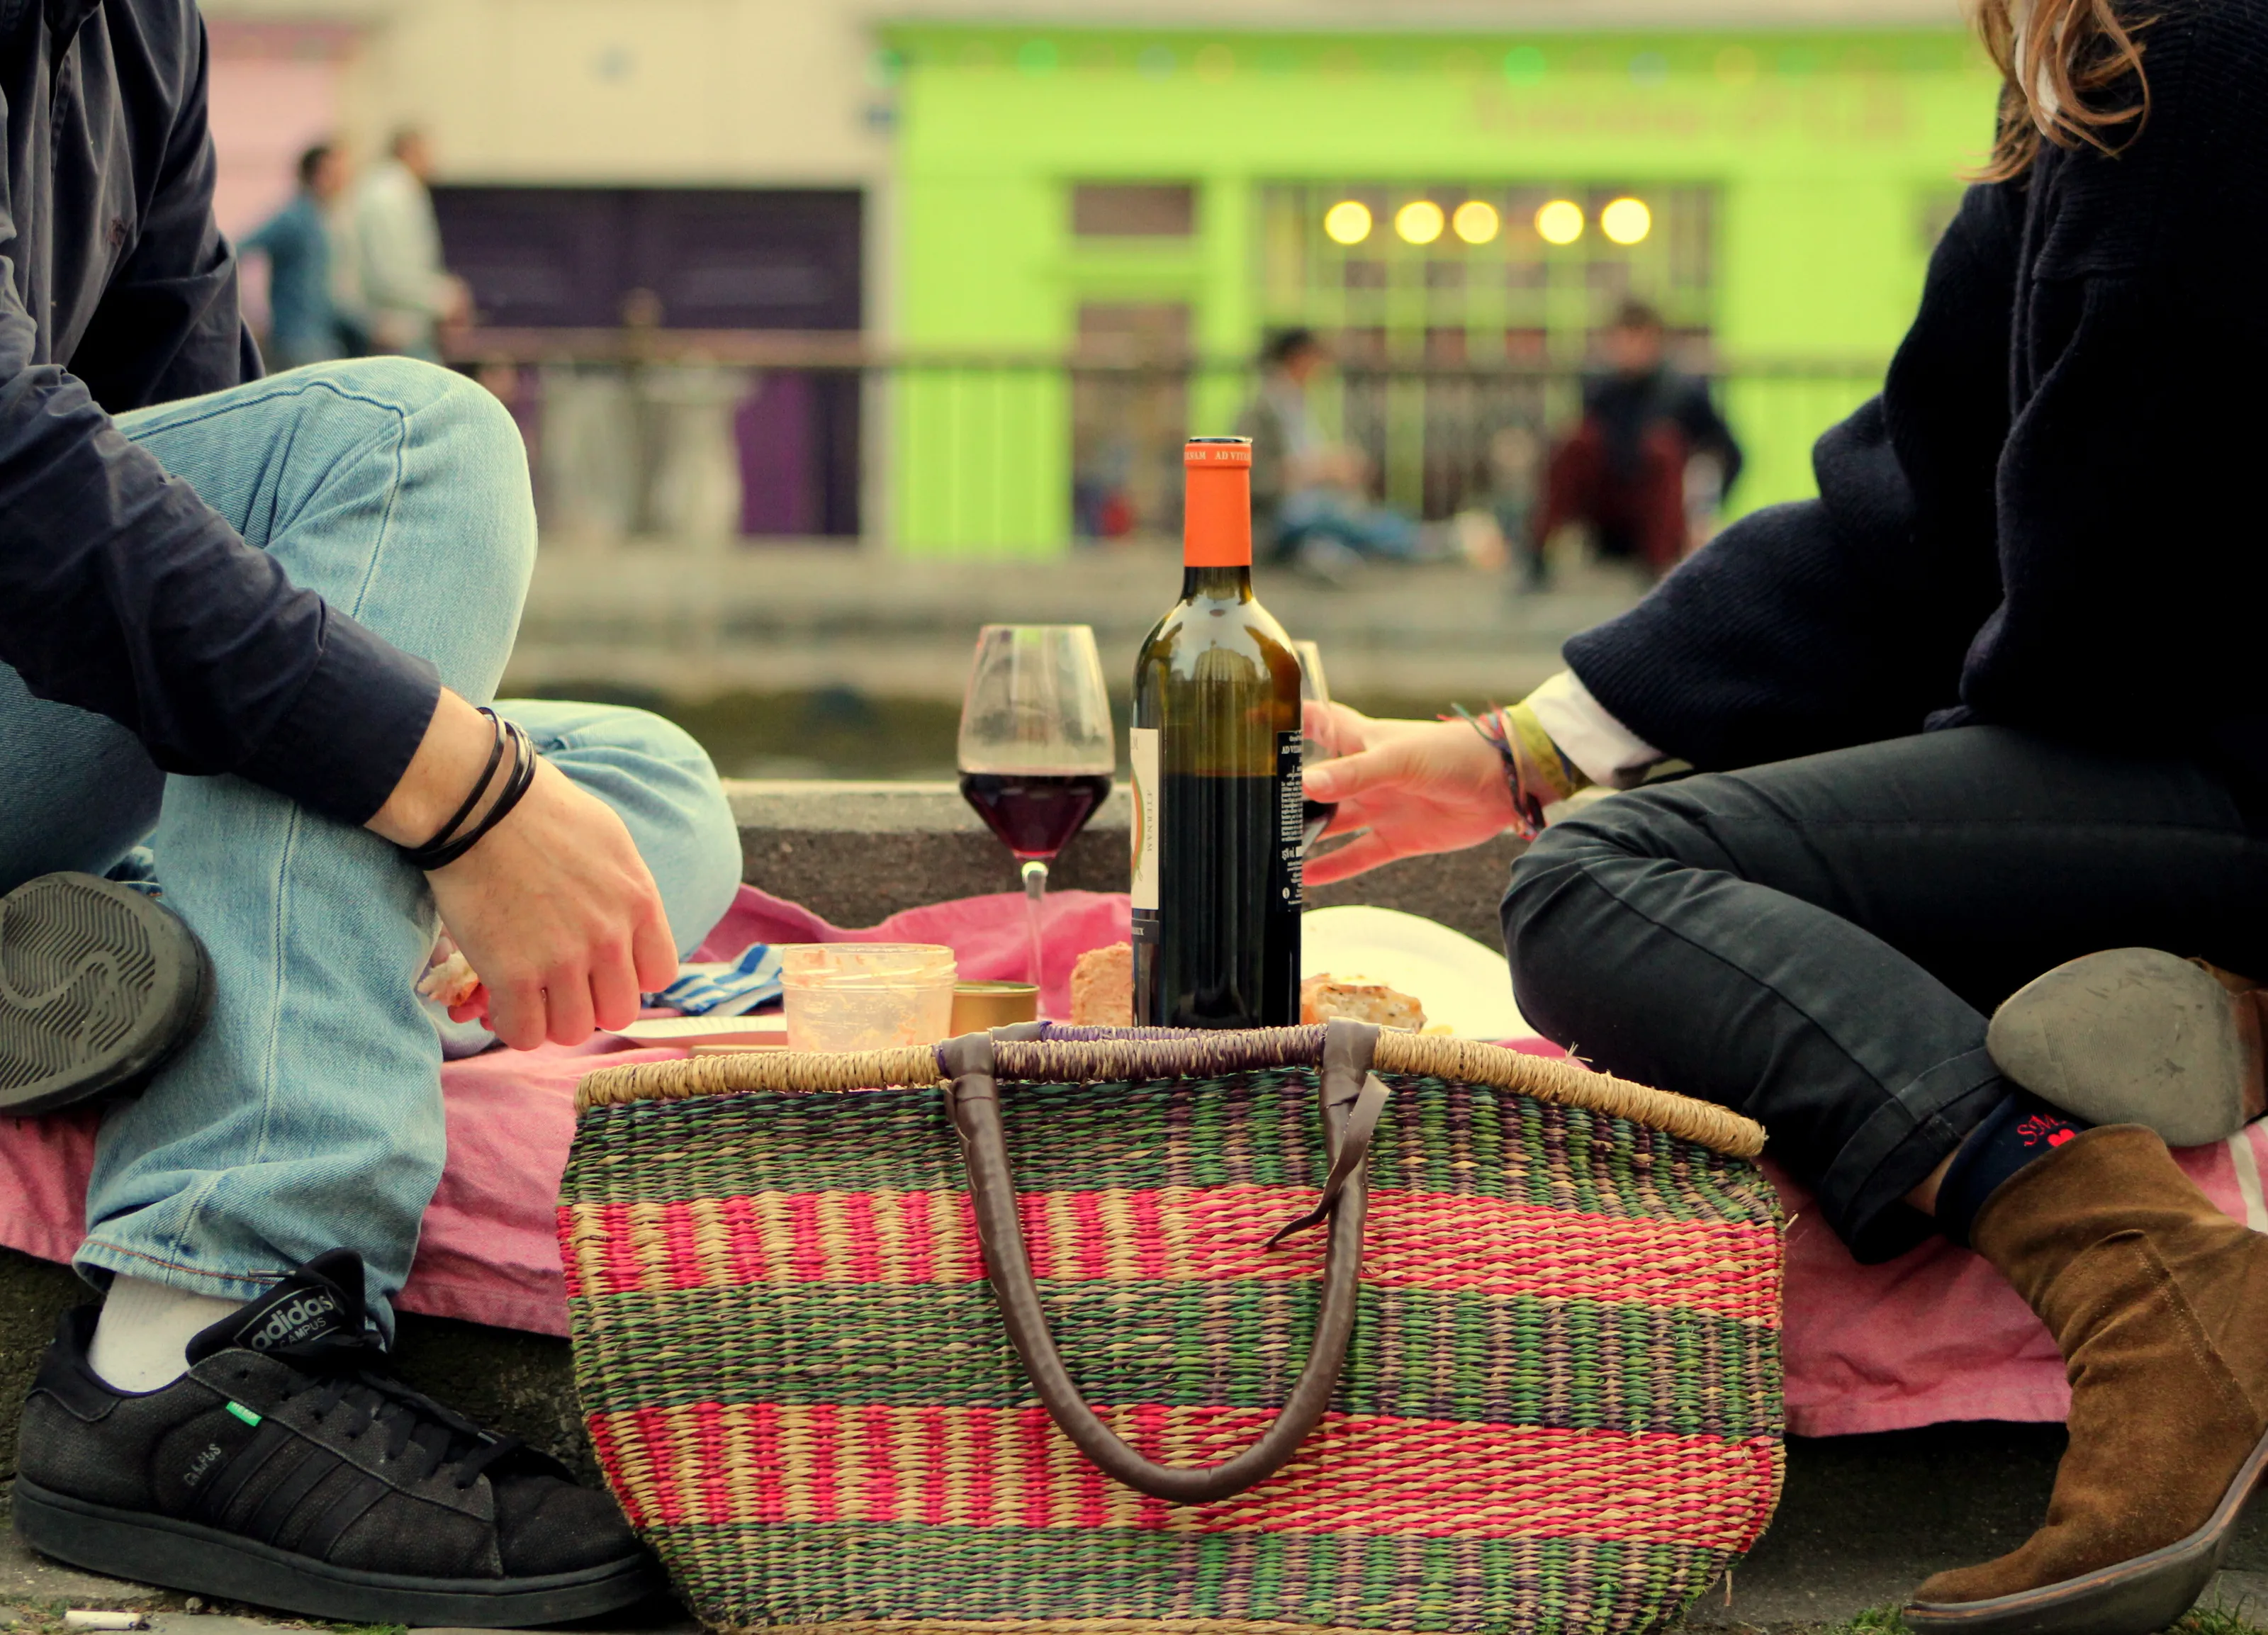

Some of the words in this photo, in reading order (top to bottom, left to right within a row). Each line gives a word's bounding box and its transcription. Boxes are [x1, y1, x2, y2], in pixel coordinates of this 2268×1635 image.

[1215, 451, 1228, 460] AD
[250, 1295, 334, 1352] adidas
[279, 1316, 327, 1349] CAMPUS
